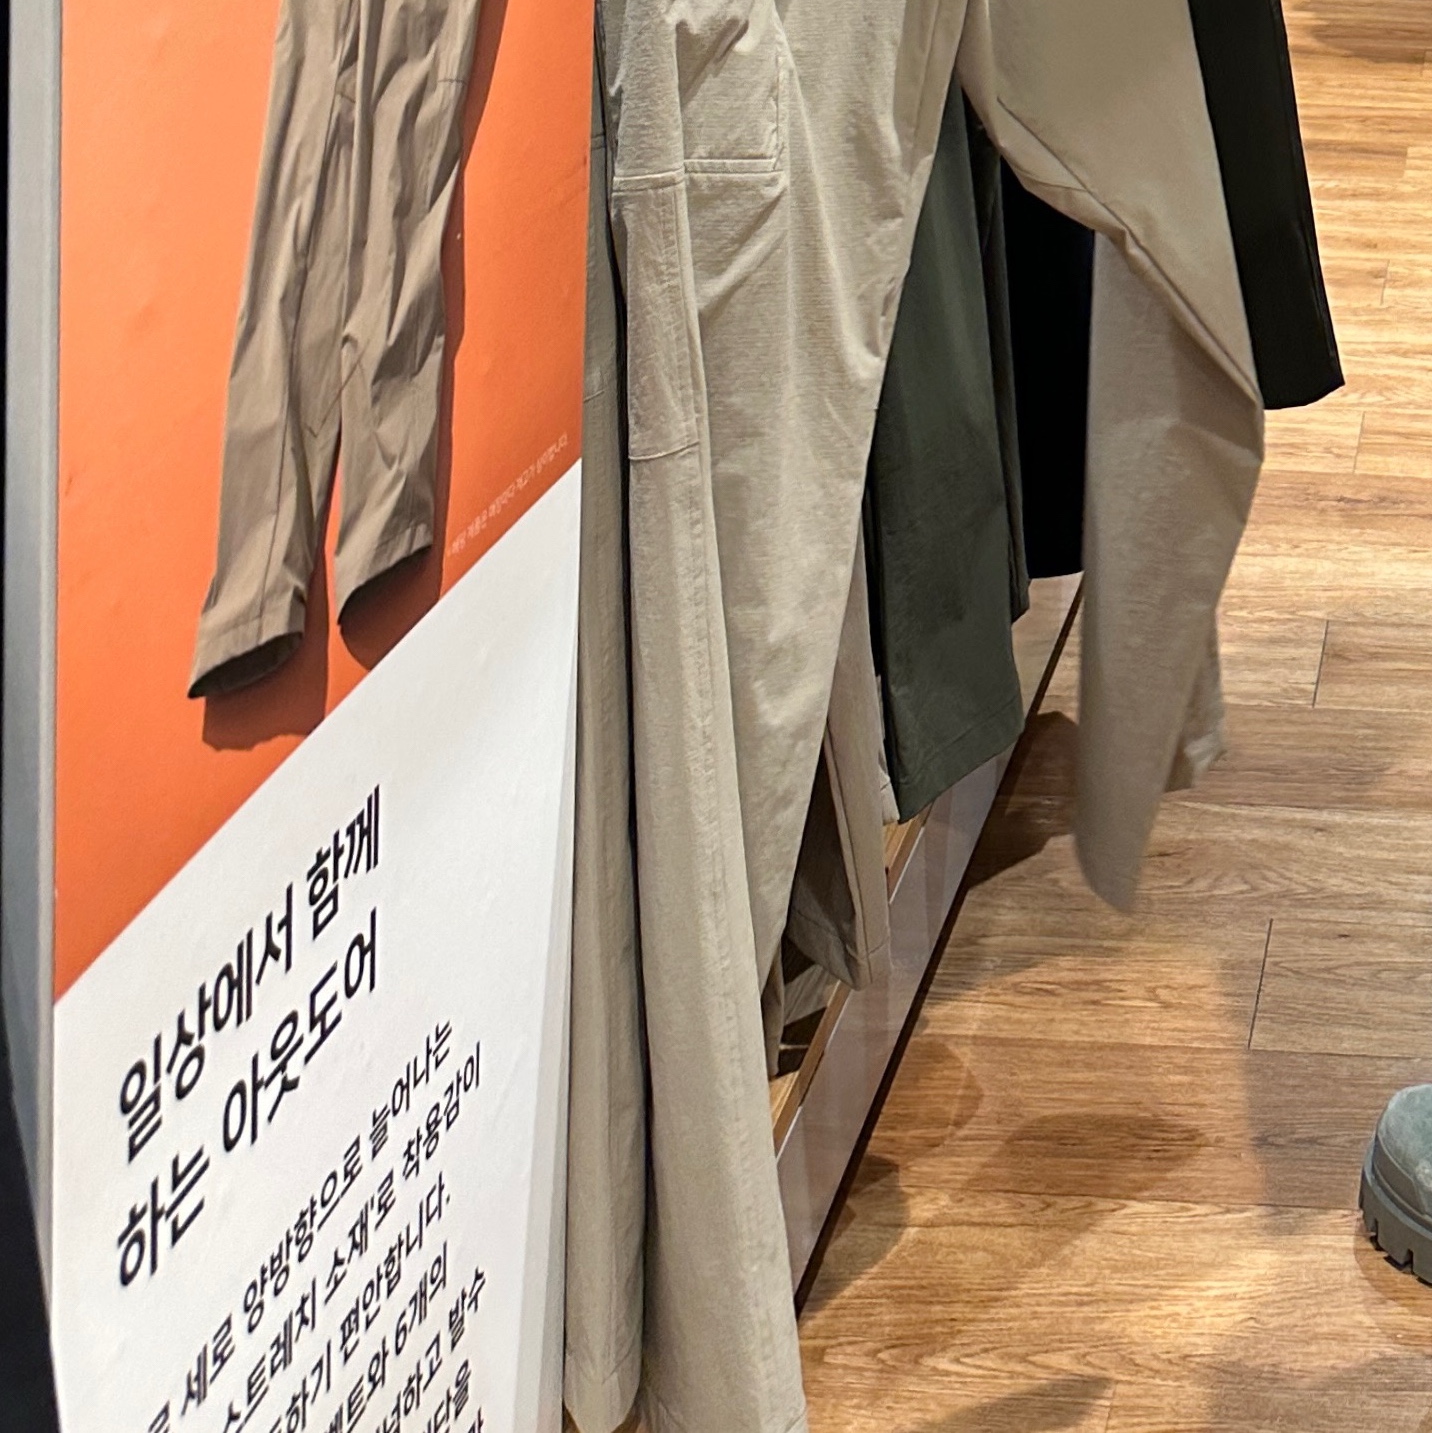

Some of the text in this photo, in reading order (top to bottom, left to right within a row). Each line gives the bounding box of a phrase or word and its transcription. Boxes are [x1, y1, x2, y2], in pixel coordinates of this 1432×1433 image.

[119, 784, 380, 1164] 일상에서 함께
[118, 907, 376, 1288] 하는 아웃도어
[402, 1041, 481, 1180] 착용감이
[181, 1021, 452, 1417] 세로 양방향으로 늘어나는
[340, 1172, 451, 1366] 편안합니다.
[395, 1241, 448, 1356] 6개의
[448, 1265, 487, 1352] 발수
